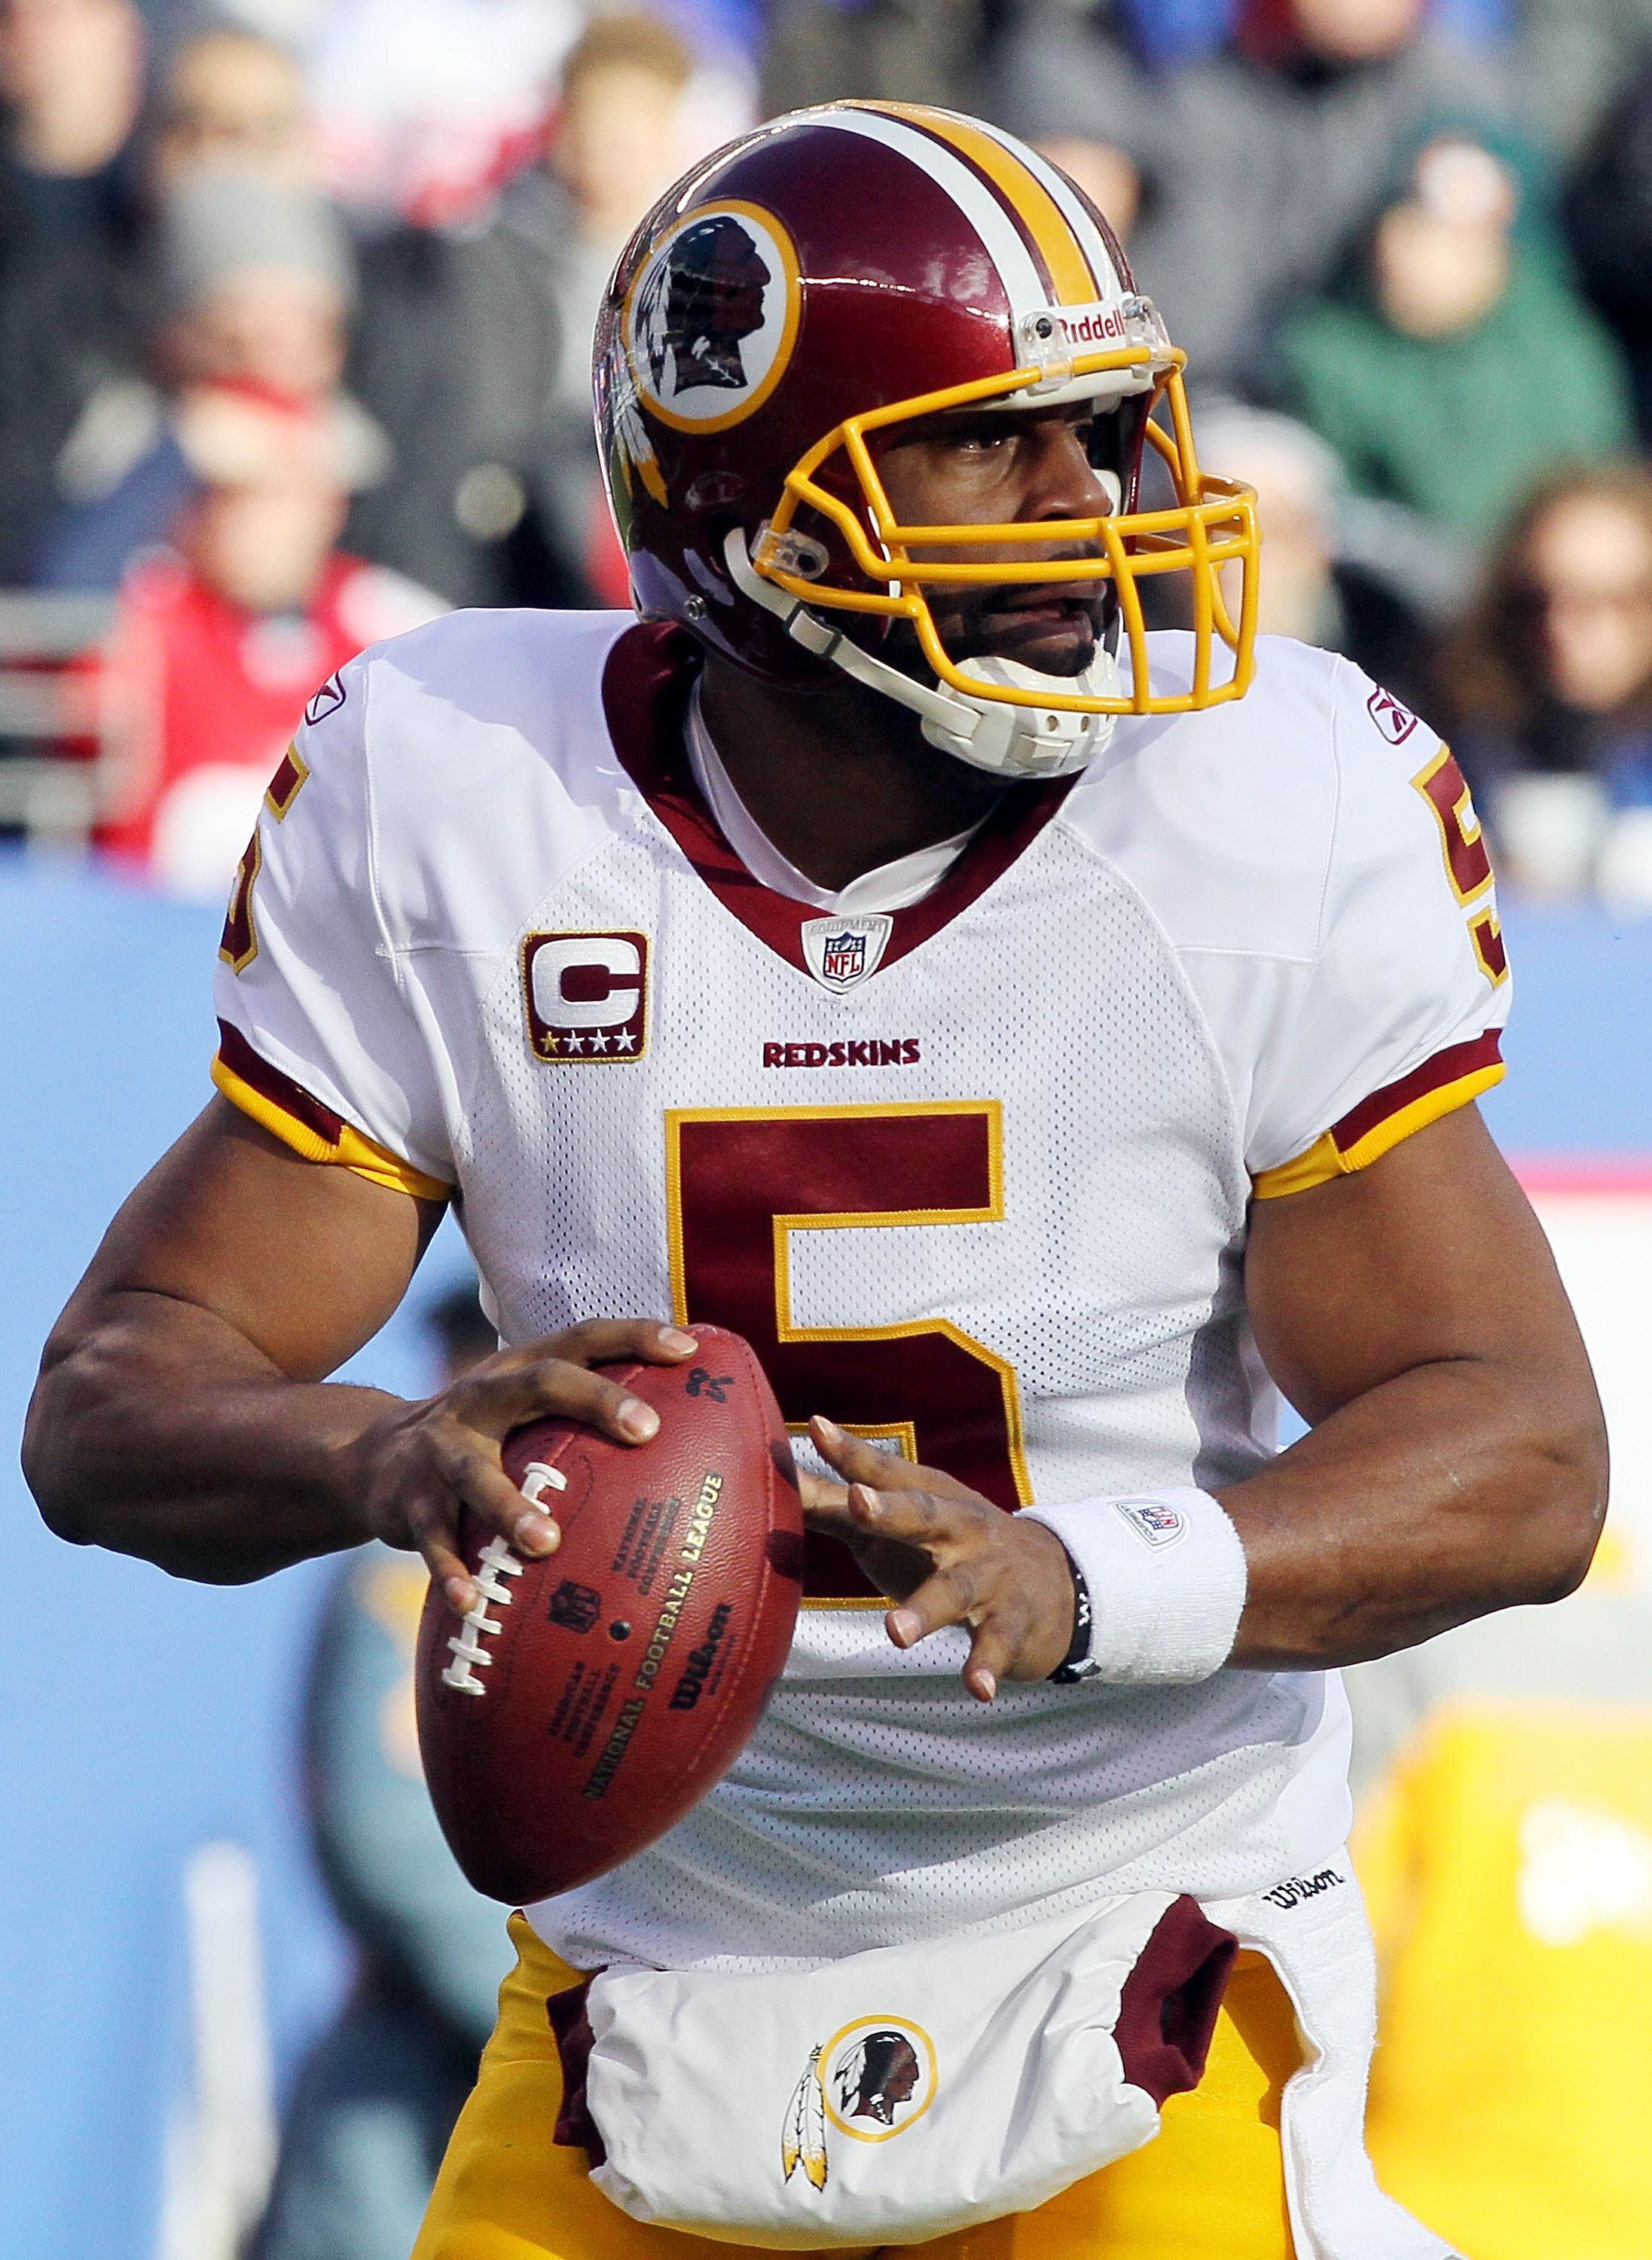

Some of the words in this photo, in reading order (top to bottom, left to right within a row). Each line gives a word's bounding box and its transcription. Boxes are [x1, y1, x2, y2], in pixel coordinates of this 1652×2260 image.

[531, 937, 640, 1028] C
[826, 954, 860, 976] NFL
[763, 1039, 921, 1068] REDSKINS
[664, 1100, 1036, 1612] 5
[584, 1698, 646, 1800] NATIONAL
[635, 1571, 694, 1691] FOOTBALL
[679, 1471, 724, 1563] LEAGUE
[668, 1604, 733, 1710] Wilson
[1262, 1869, 1345, 1910] Wilson
